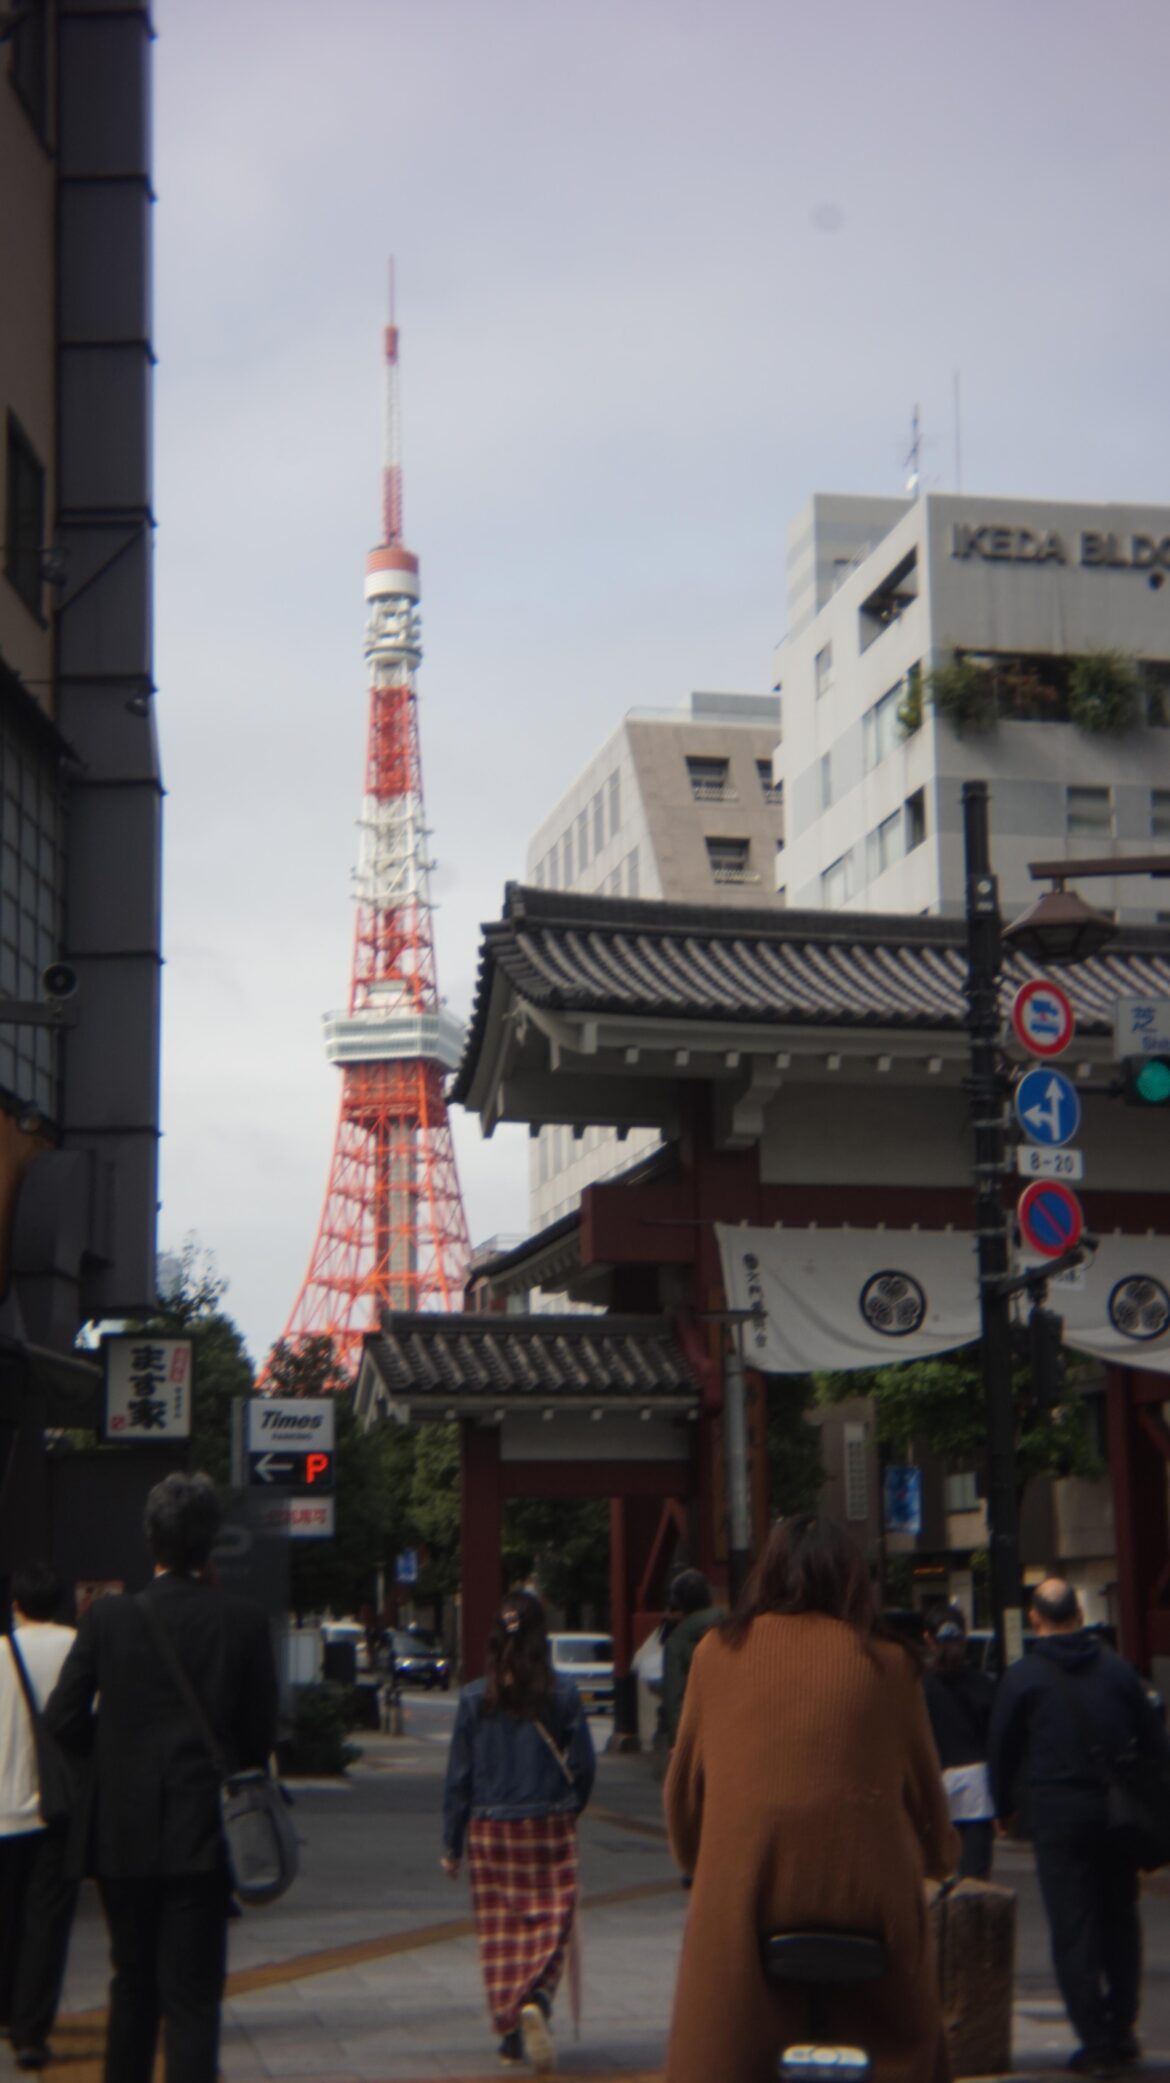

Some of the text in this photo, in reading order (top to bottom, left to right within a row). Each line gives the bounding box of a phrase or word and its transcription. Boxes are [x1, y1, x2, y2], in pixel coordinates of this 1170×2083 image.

[951, 523, 1066, 566] IKEDA
[1029, 1150, 1074, 1173] 8-20
[261, 1409, 324, 1429] Times
[305, 1453, 328, 1483] P
